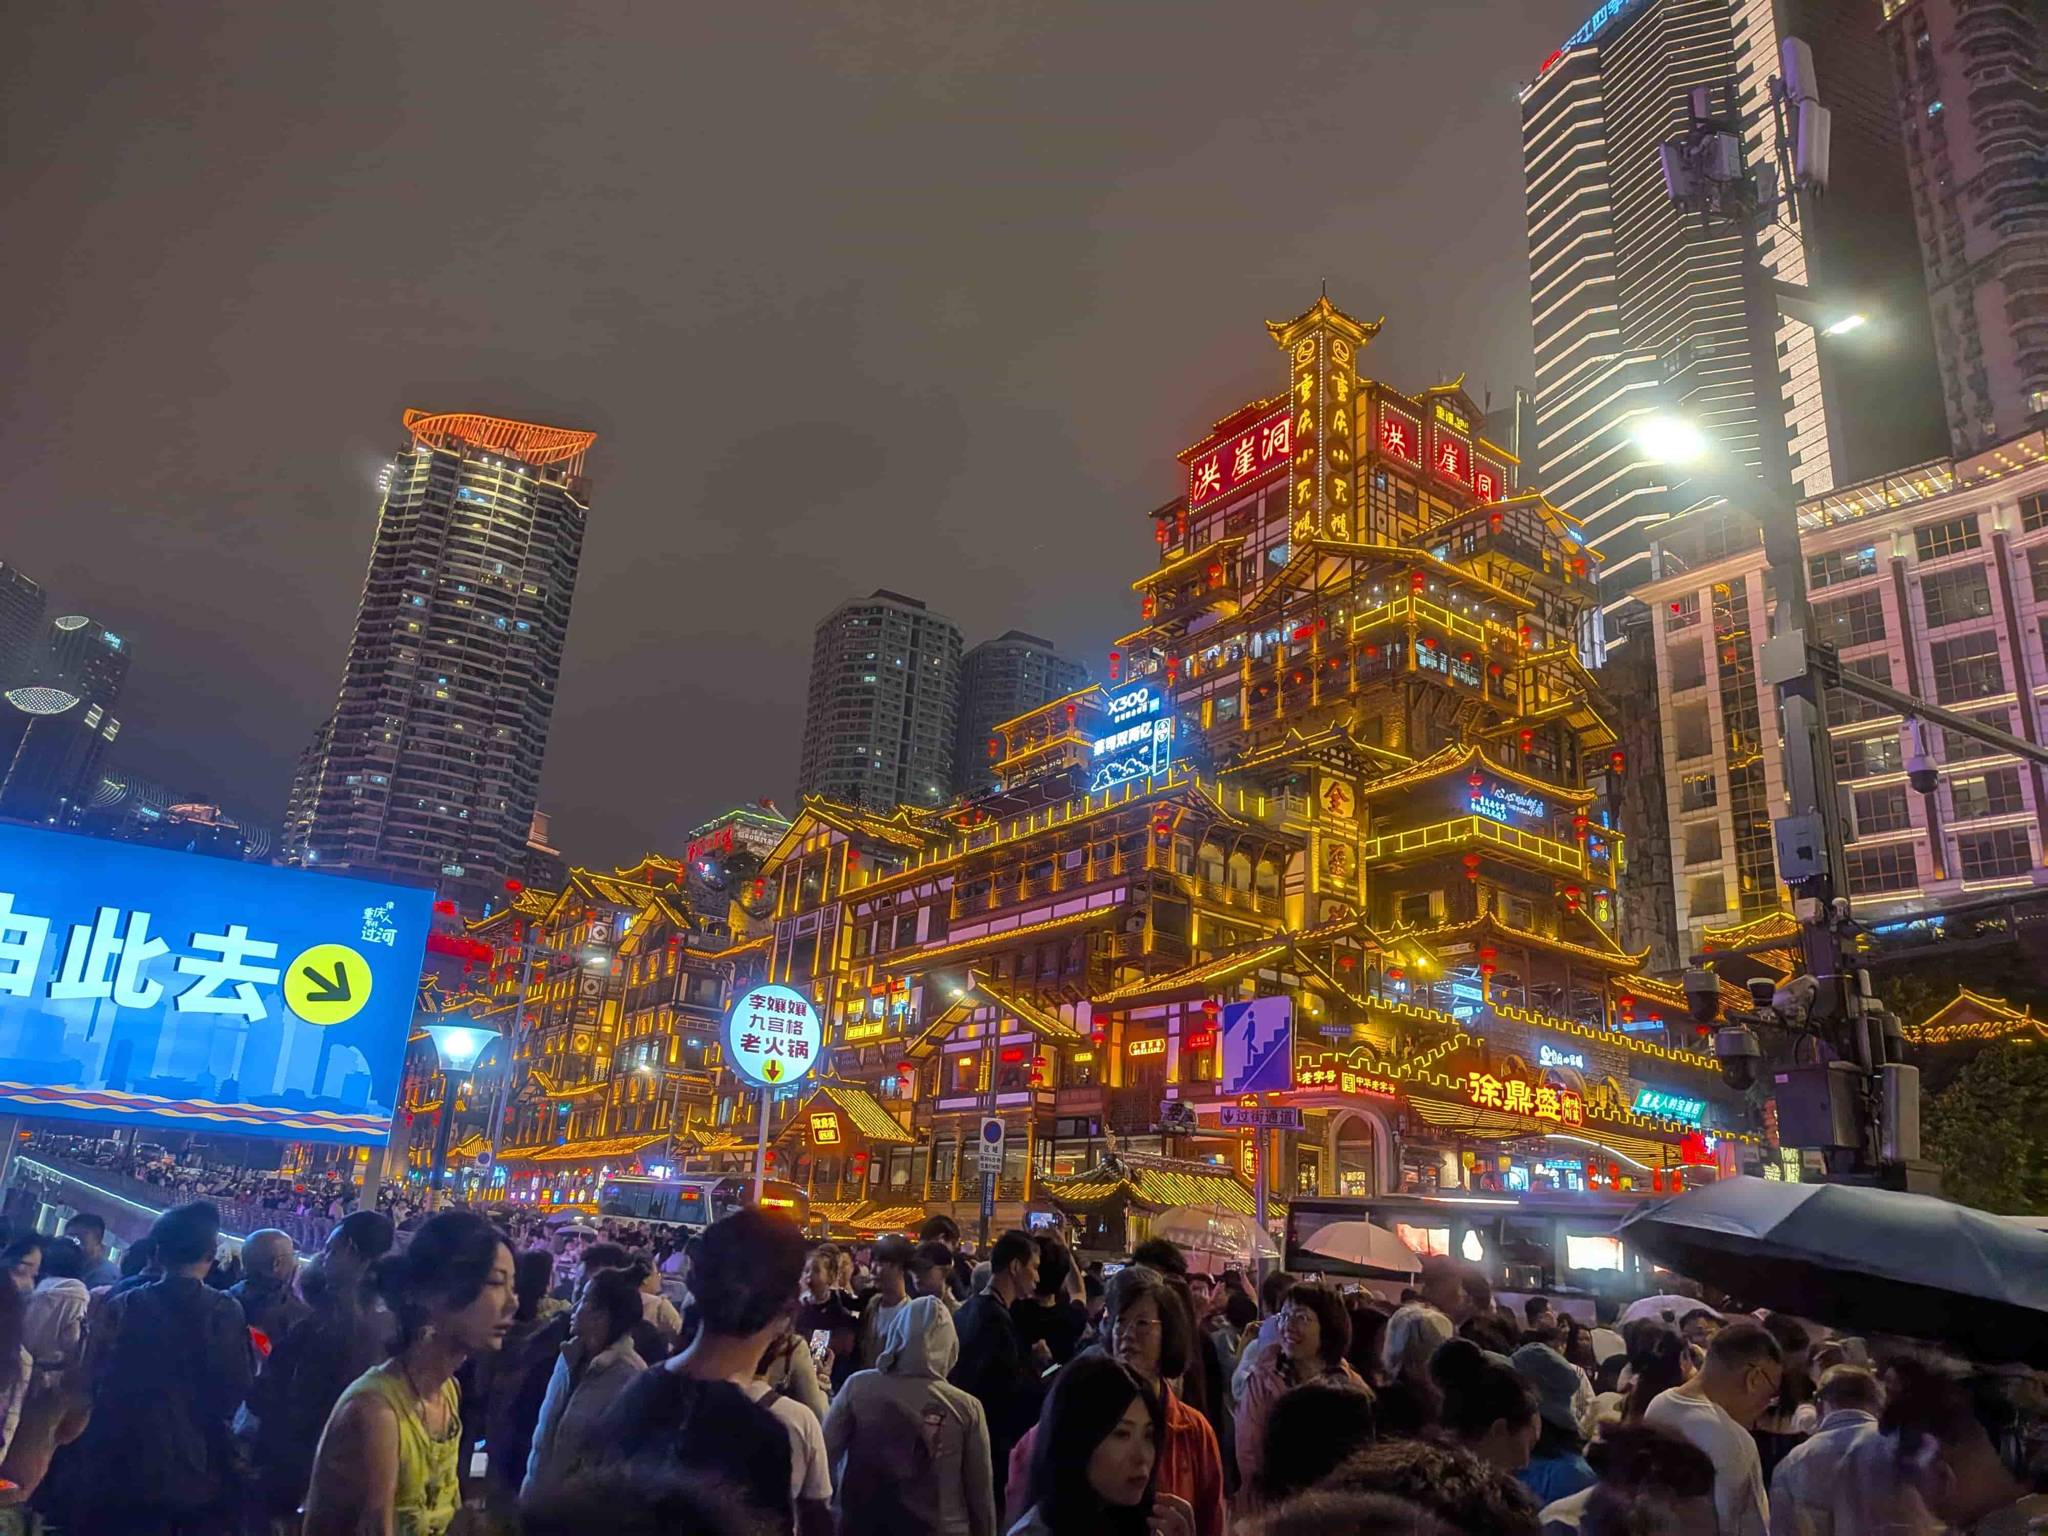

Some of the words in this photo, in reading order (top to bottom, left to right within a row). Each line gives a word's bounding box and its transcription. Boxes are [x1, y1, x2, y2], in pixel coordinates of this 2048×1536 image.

[1194, 418, 1290, 501] 洪崖洞
[1294, 372, 1314, 543] 重庆小天鹅
[1331, 371, 1349, 542] 重庆小天鹅
[1108, 687, 1149, 716] X300
[361, 926, 397, 947] 过河
[748, 1013, 804, 1036] 九宫格
[740, 1033, 809, 1060] 老火锅
[1468, 1072, 1562, 1122] 徐鼎盛
[1236, 1110, 1294, 1125] 过街通道
